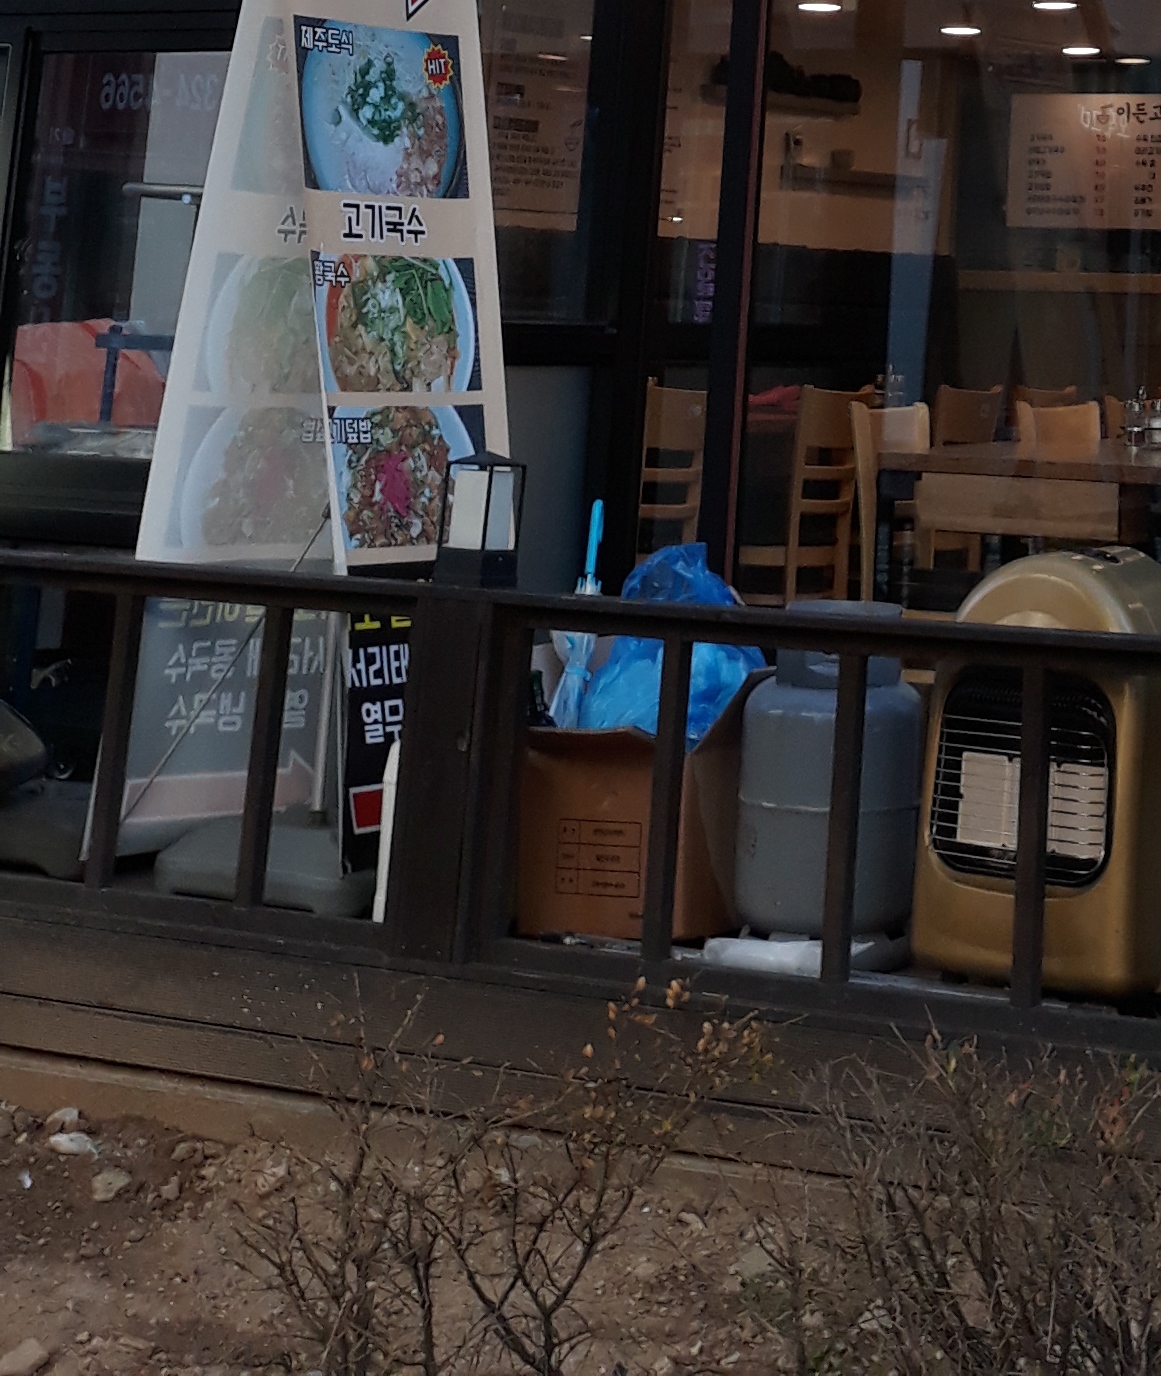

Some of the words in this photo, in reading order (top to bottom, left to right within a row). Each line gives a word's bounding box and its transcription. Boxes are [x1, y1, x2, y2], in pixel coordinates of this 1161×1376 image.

[300, 24, 355, 57] 제주도식
[427, 55, 448, 75] HIT
[342, 202, 426, 244] 고기국수
